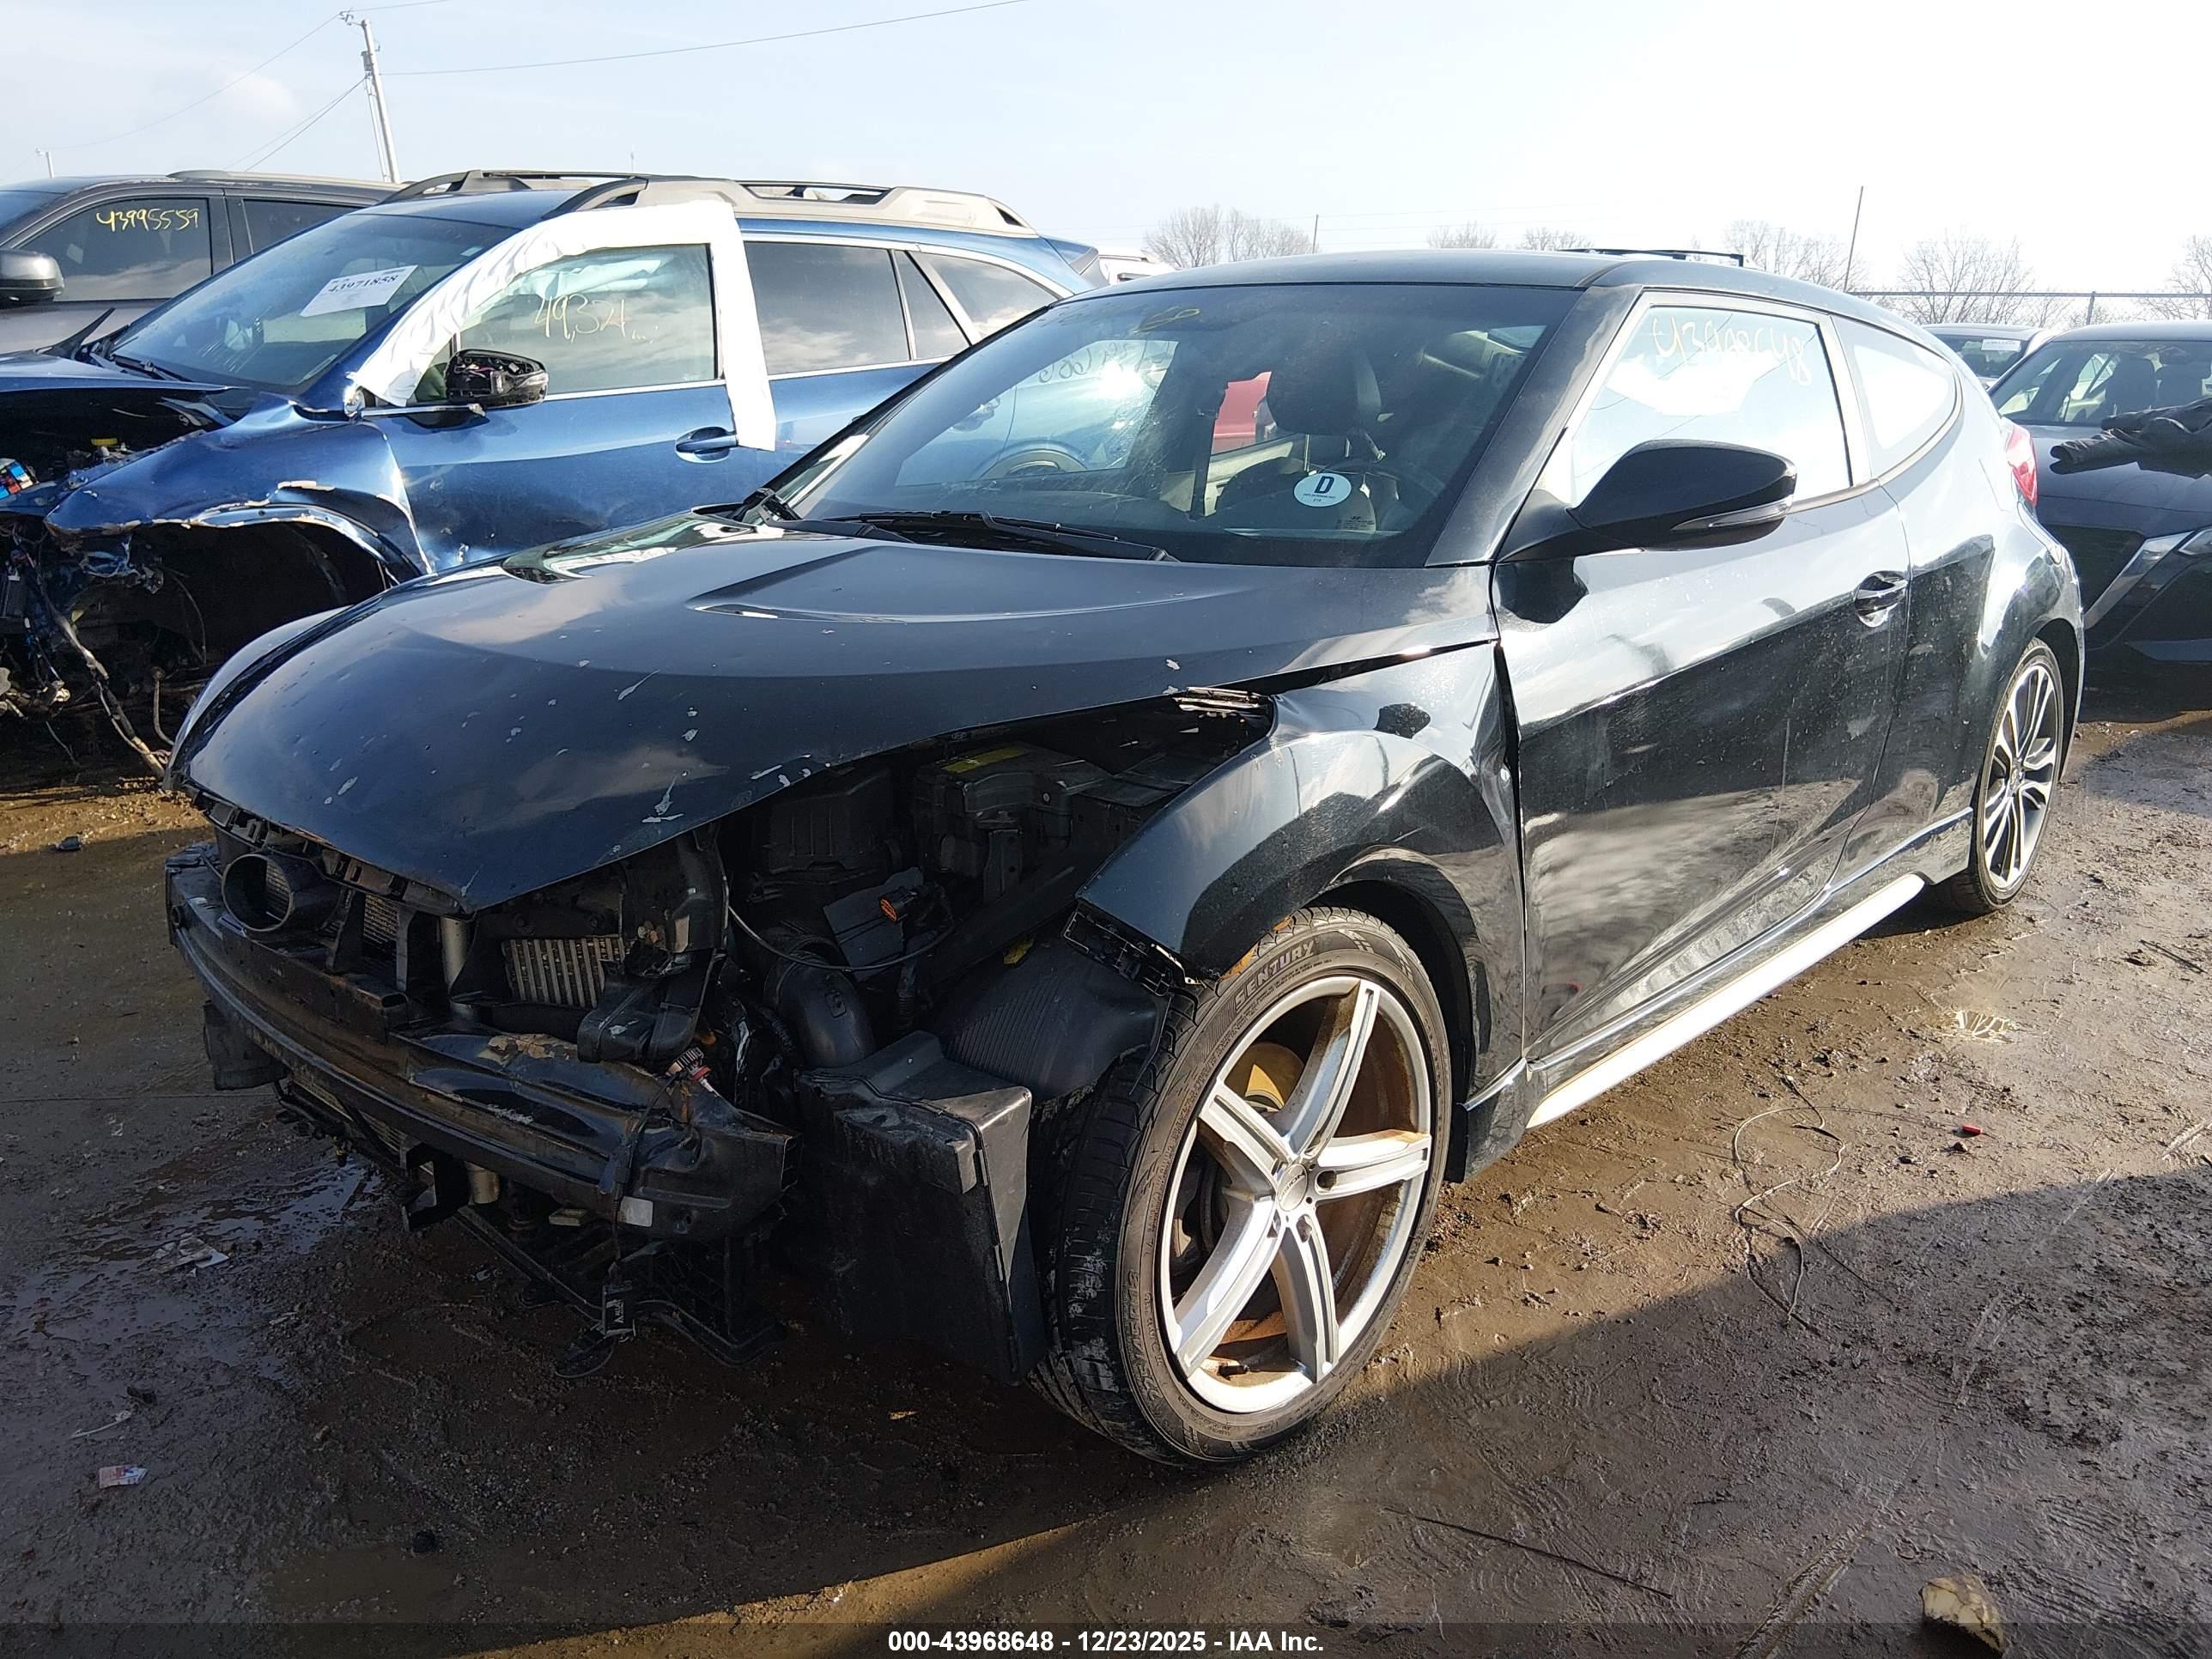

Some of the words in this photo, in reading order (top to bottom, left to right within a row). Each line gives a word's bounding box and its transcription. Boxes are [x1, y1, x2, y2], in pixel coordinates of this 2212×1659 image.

[96, 208, 199, 232] 43995559
[1314, 476, 1334, 494] D
[1234, 939, 1316, 1011] SENTURY
